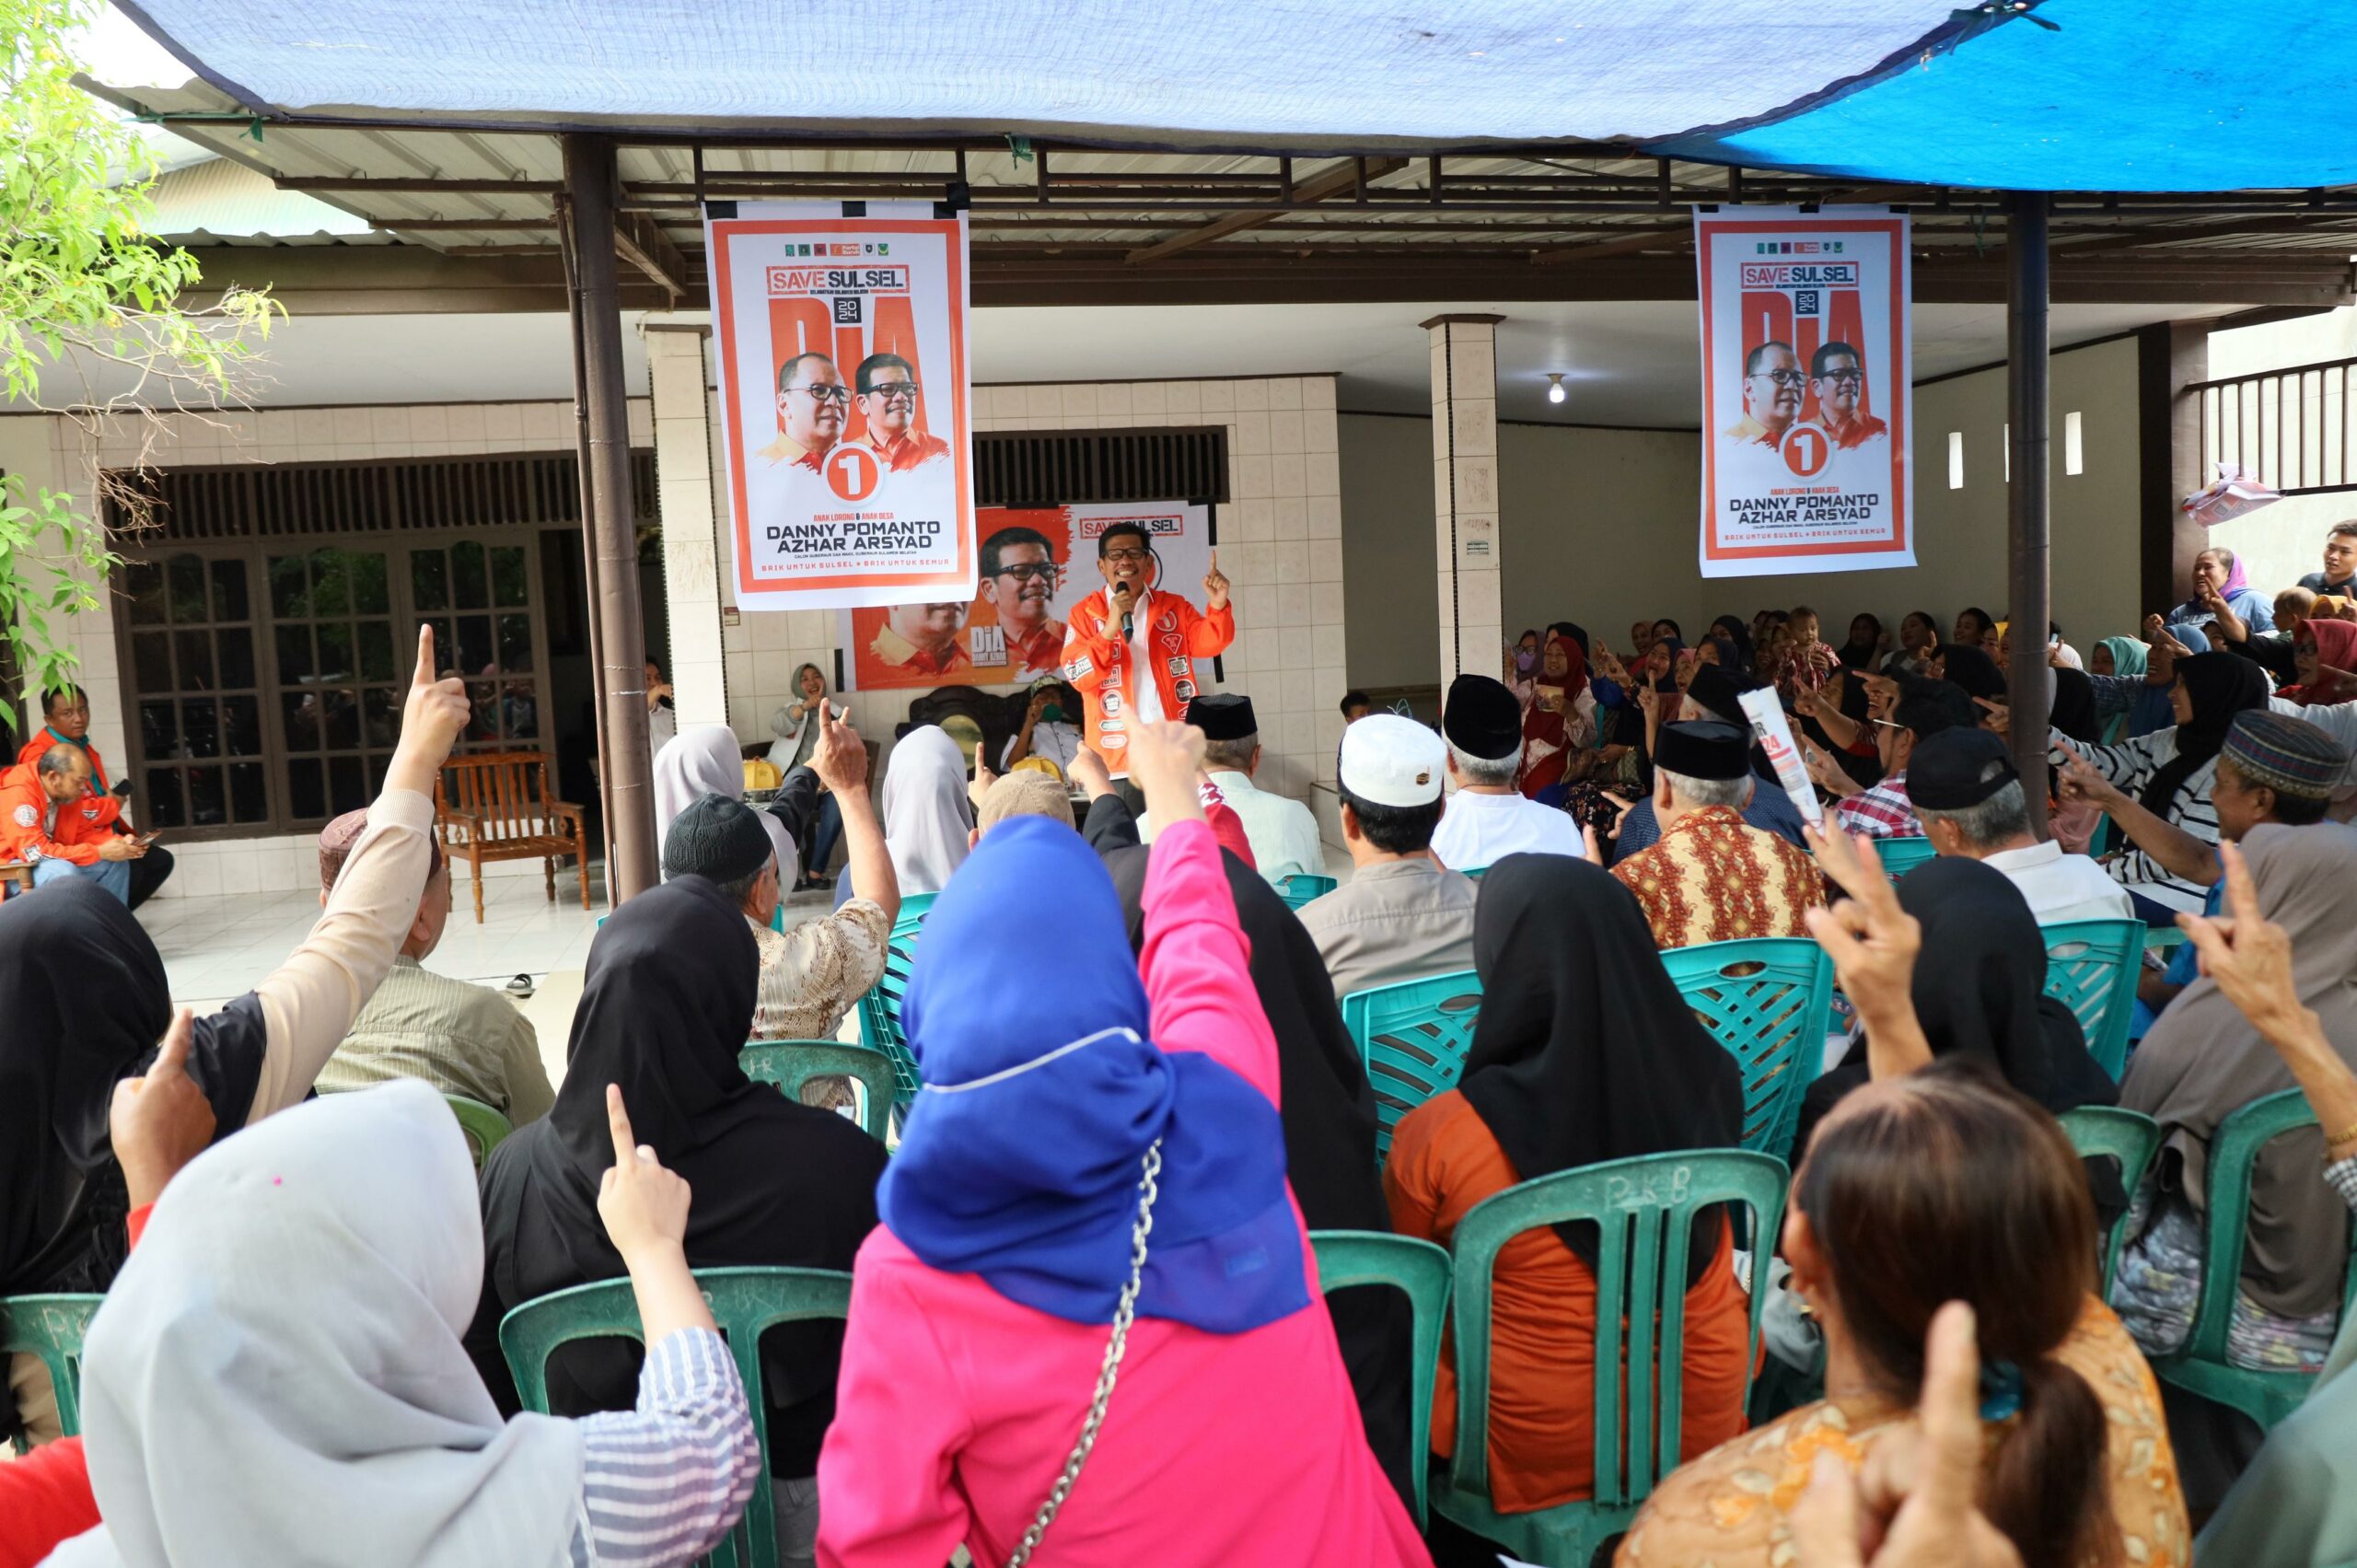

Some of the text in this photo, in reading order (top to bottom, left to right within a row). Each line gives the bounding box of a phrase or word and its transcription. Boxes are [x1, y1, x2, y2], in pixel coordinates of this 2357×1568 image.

[773, 270, 903, 290] SAVE SULSEL
[1746, 266, 1854, 284] SAVE SULSEL
[838, 300, 857, 310] 20
[839, 310, 857, 320] 24
[1794, 434, 1814, 471] 1
[838, 455, 862, 495] 1
[1730, 494, 1879, 511] DANNY POMANTO
[813, 514, 830, 522] ANAK
[830, 513, 855, 522] LORONG
[862, 512, 878, 520] ANAK
[878, 512, 894, 520] DESA
[1738, 506, 1871, 524] AZHAR ARSYAD
[766, 520, 941, 540] DANNY POMANTO
[1084, 520, 1121, 534] SAV
[777, 535, 932, 553] AZHAR ARSYAD
[786, 563, 817, 571] UNTUK
[819, 561, 853, 569] SULSEL
